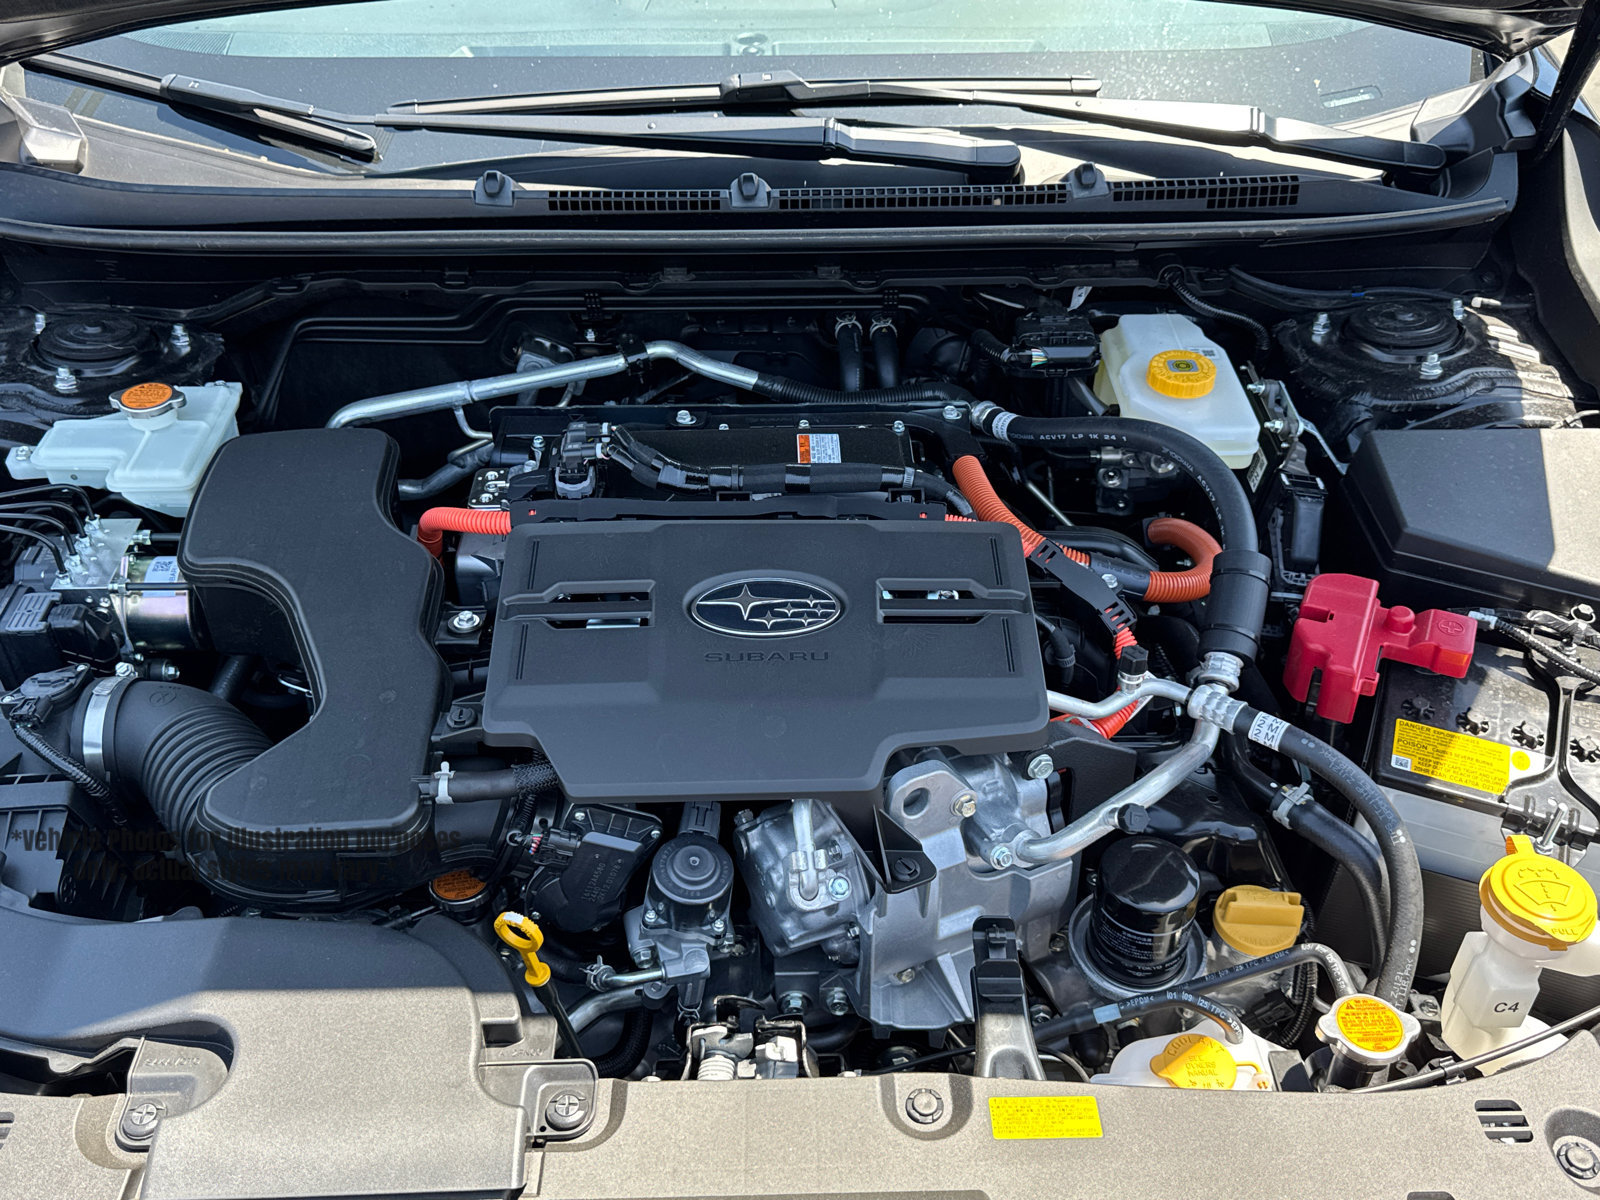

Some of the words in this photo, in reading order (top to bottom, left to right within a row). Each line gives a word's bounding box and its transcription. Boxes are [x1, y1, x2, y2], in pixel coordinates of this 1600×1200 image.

[704, 651, 829, 662] SUBARU
[1257, 719, 1265, 728] 2
[1267, 723, 1280, 734] M
[1399, 720, 1431, 732] DANGER
[1254, 728, 1262, 737] 2
[1264, 732, 1275, 743] M
[1397, 738, 1428, 750] POISON
[1432, 763, 1443, 771] OUT
[1390, 971, 1404, 998] ZJ121
[1210, 1003, 1226, 1019] TPC
[1494, 1002, 1520, 1013] C4
